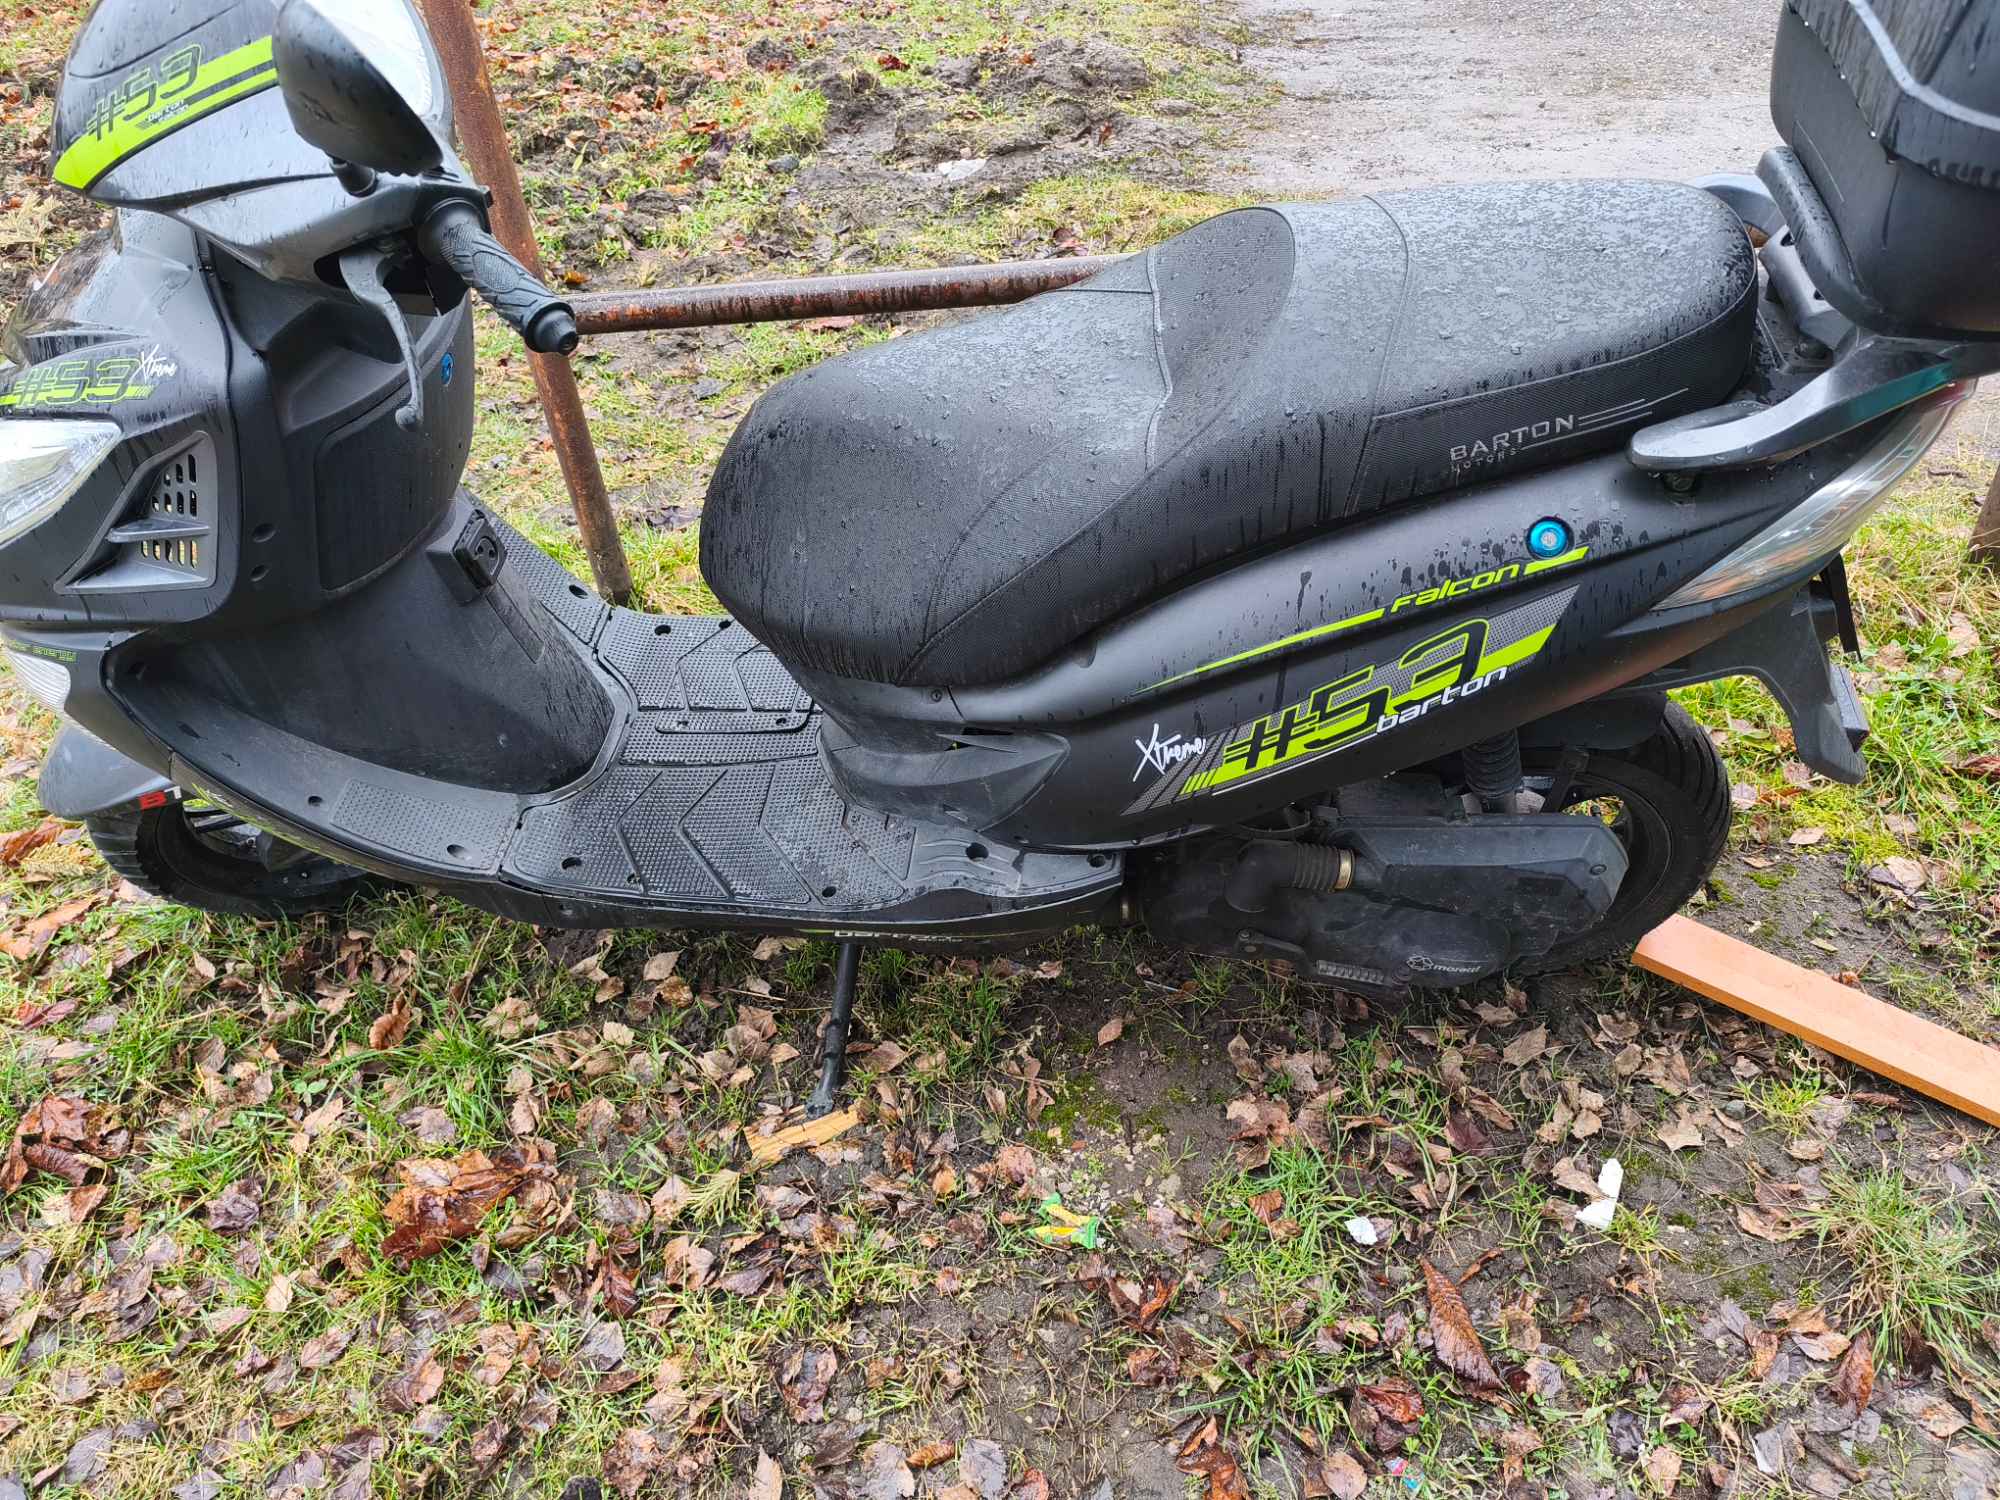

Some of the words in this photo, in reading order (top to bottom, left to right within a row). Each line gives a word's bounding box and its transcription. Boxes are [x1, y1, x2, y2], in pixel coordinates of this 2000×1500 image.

[86, 43, 202, 141] #53
[13, 357, 143, 408] #53
[127, 344, 178, 386] Xtreme
[1450, 414, 1575, 461] BARTON
[1222, 618, 1490, 770] #53
[1376, 666, 1508, 734] barton
[1132, 722, 1207, 782] Xtreme
